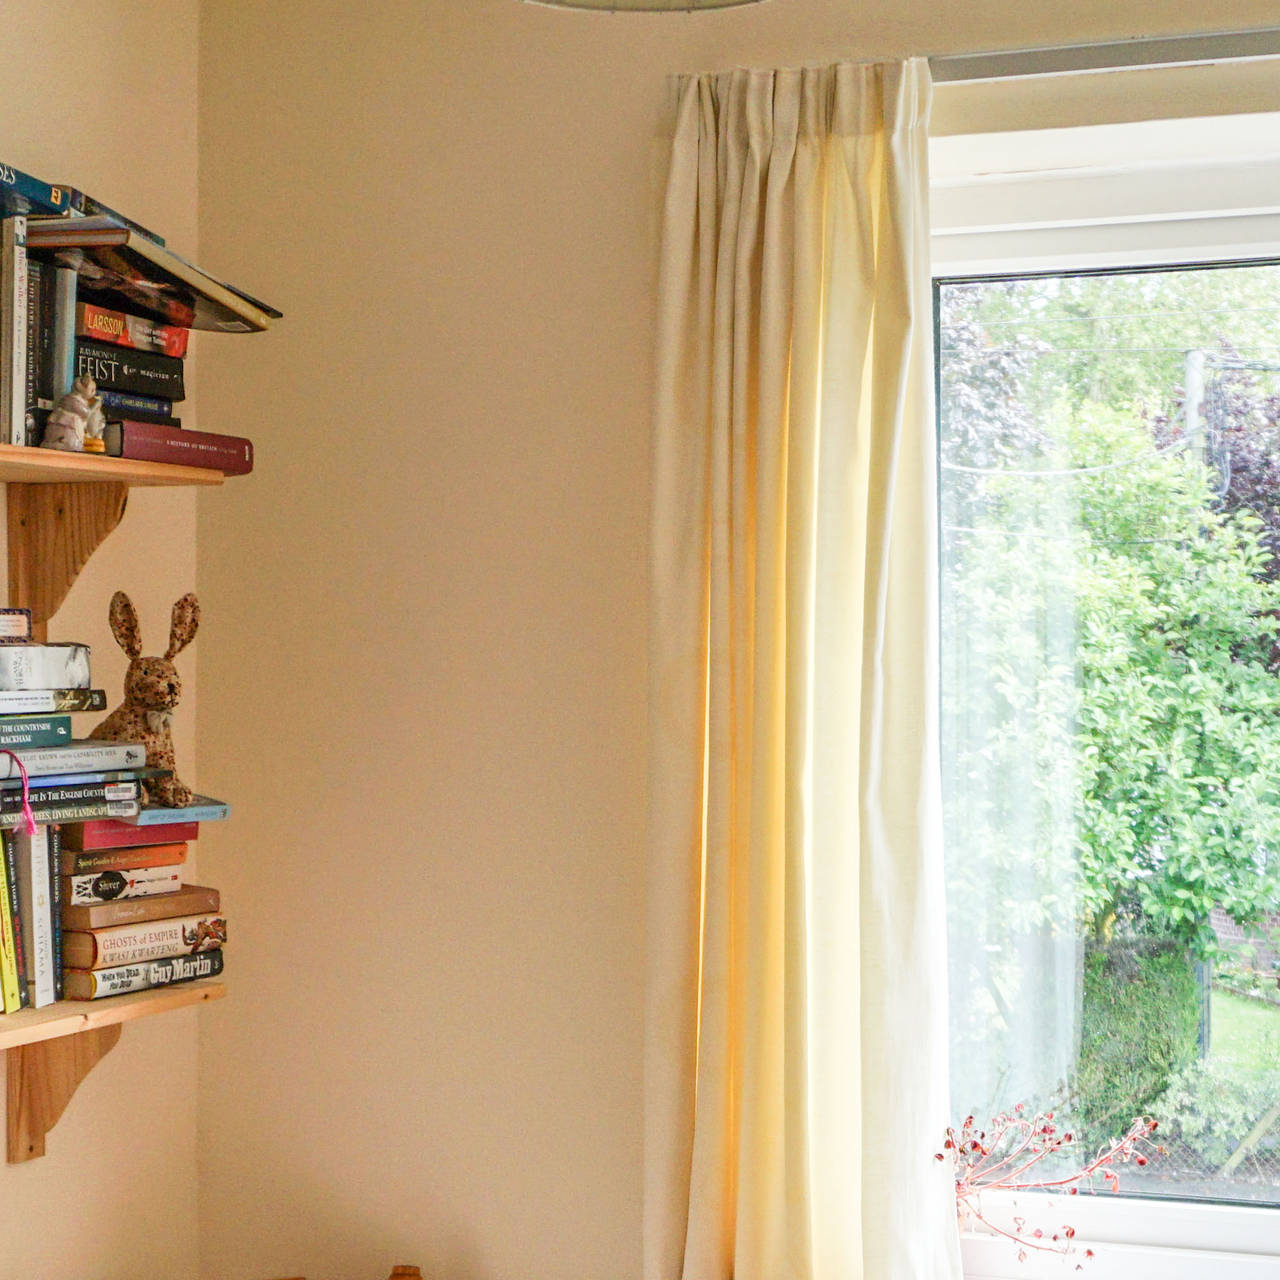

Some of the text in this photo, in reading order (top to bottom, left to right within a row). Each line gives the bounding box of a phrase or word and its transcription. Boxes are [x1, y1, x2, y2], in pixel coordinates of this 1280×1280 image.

[87, 314, 124, 336] LARSSON
[78, 356, 120, 382] FEIST
[0, 735, 31, 744] RACKHAM
[99, 878, 120, 890] Shiver
[103, 929, 180, 951] GHOSTS of EMPIRE
[102, 942, 179, 963] KWASI KWARTENG
[150, 955, 211, 984] Guy Martin
